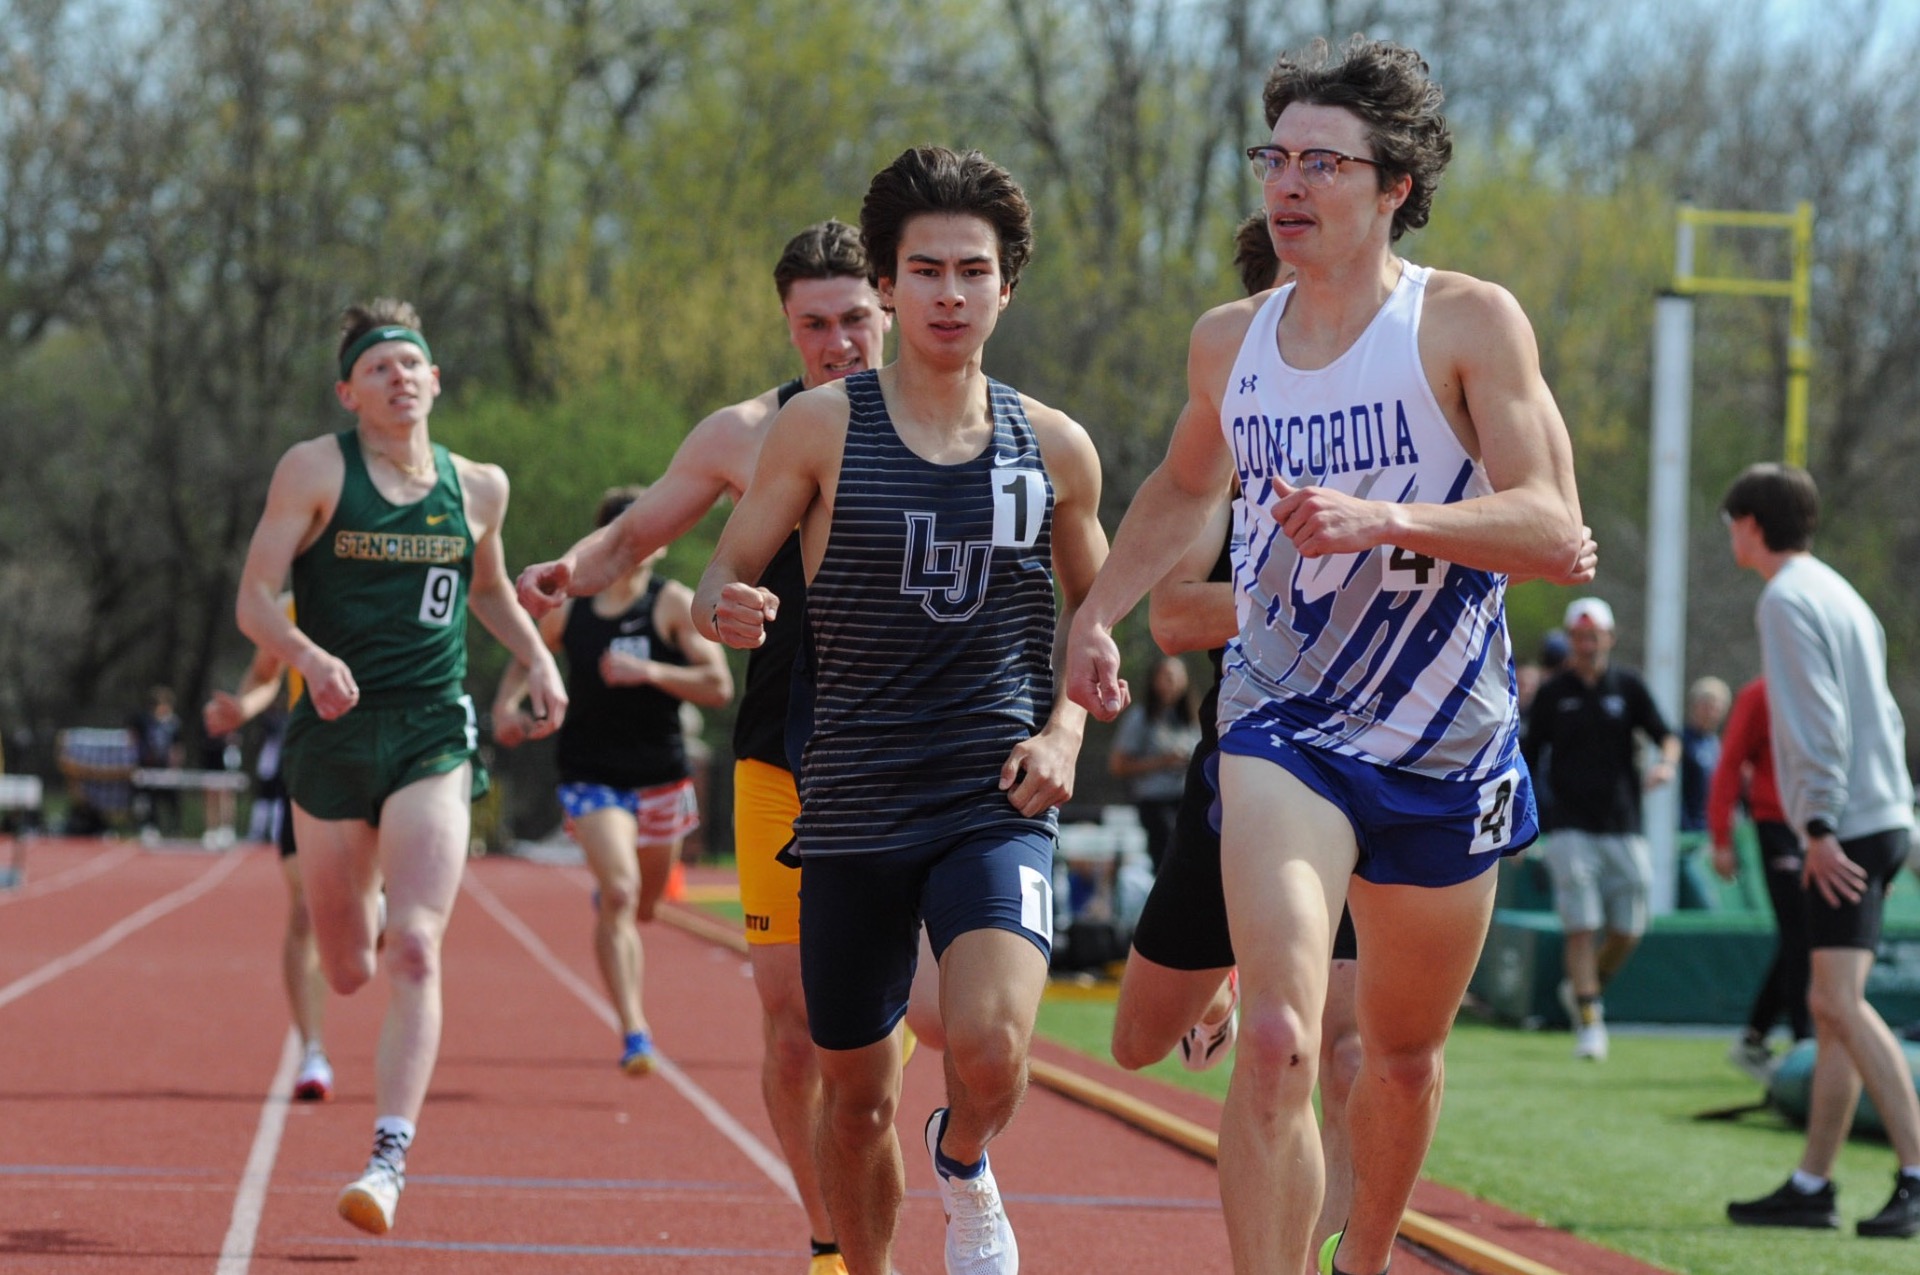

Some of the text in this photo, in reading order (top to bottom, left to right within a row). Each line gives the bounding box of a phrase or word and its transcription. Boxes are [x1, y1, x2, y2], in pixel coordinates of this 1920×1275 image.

[1233, 399, 1419, 480] CONCORDIA
[1002, 474, 1027, 542] 1
[430, 575, 452, 618] 9
[900, 511, 993, 622] LU
[1480, 778, 1511, 844] 4
[1030, 879, 1048, 935] 1
